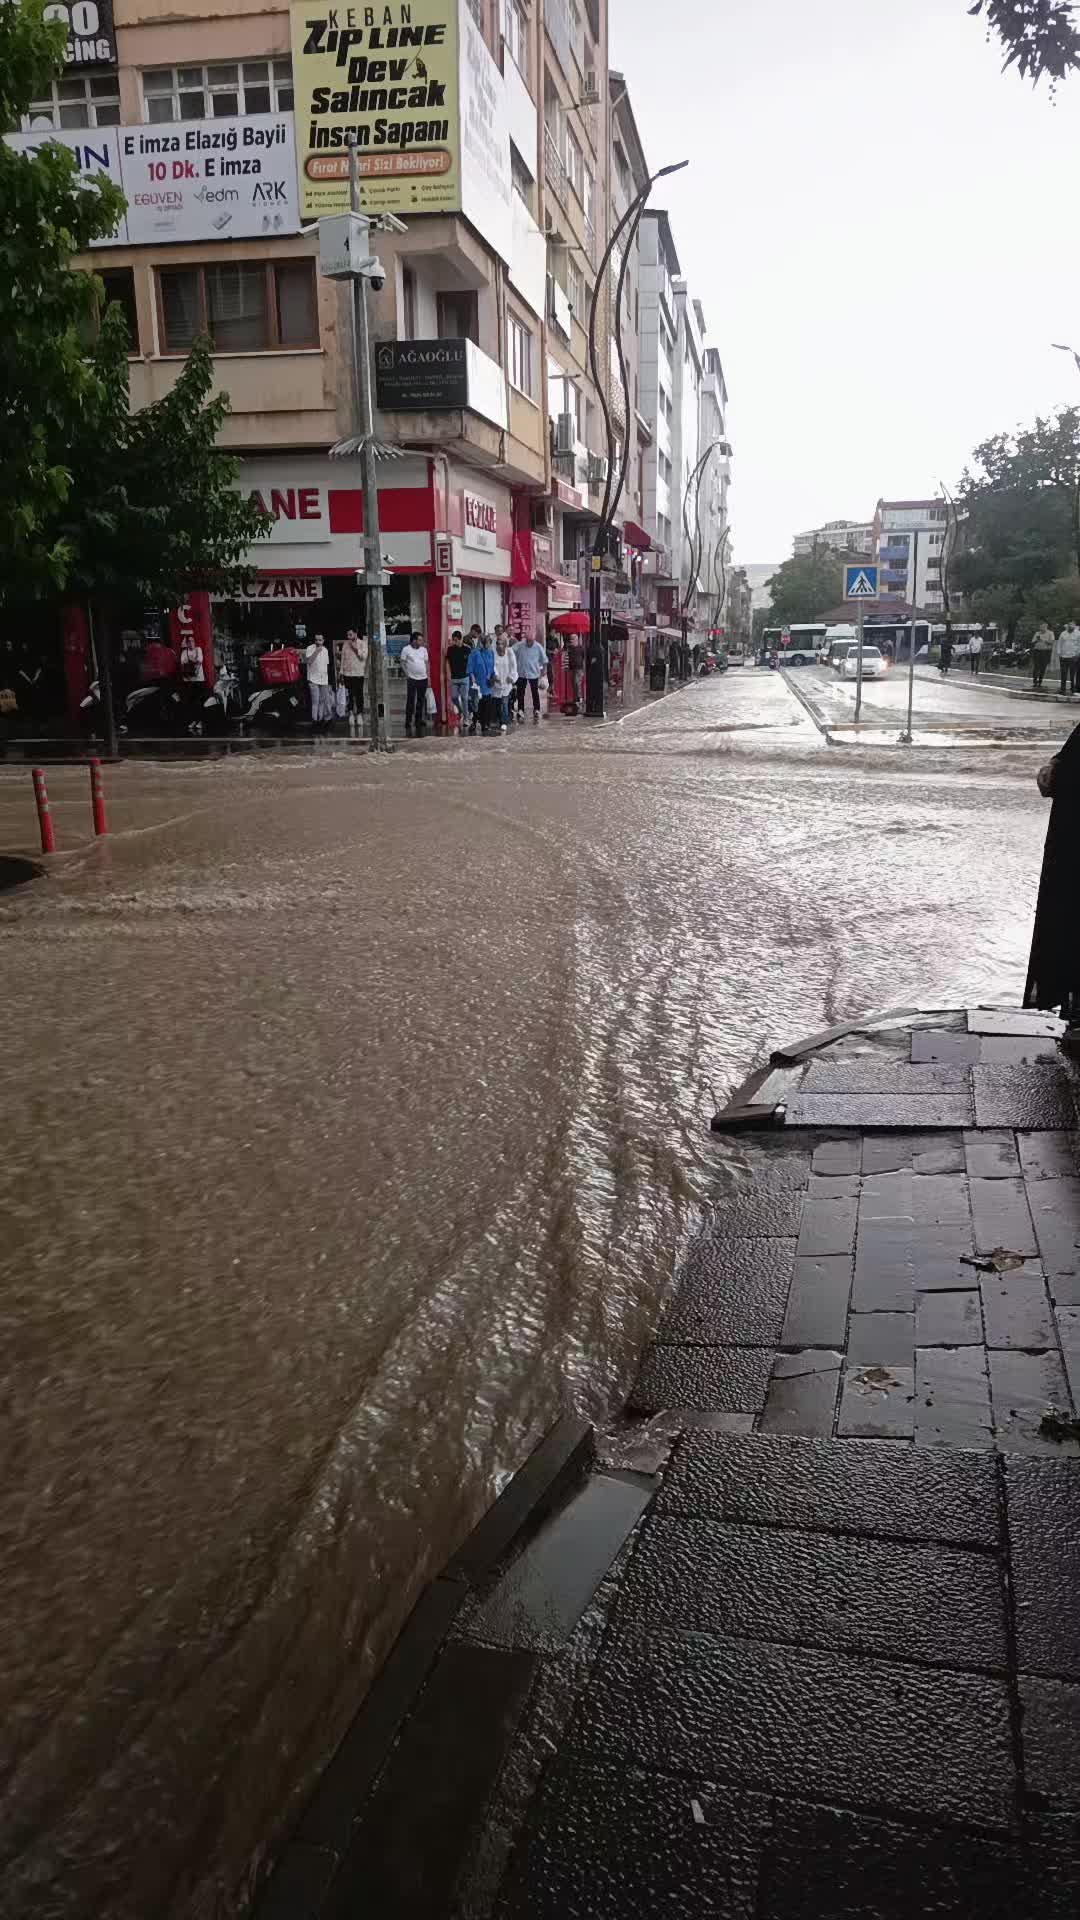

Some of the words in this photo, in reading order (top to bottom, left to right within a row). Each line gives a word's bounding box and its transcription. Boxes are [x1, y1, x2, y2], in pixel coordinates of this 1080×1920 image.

[329, 4, 411, 29] KEBAN
[368, 24, 447, 49] LINE
[348, 56, 408, 84] Dev
[311, 80, 447, 114] Salıncak
[124, 136, 134, 155] E
[140, 135, 180, 154] imza
[185, 128, 237, 151] Elazığ
[243, 124, 286, 148] Bayii
[374, 118, 449, 148] Sapanı
[148, 162, 167, 181] 10
[172, 160, 199, 179] Dk.
[205, 158, 215, 177] E
[220, 157, 261, 176] imza
[374, 157, 393, 171] Sizi
[396, 154, 444, 171] Bekliyor!
[252, 181, 287, 201] ARK
[399, 349, 464, 363] AĞAOĞLU
[440, 548, 448, 568] E
